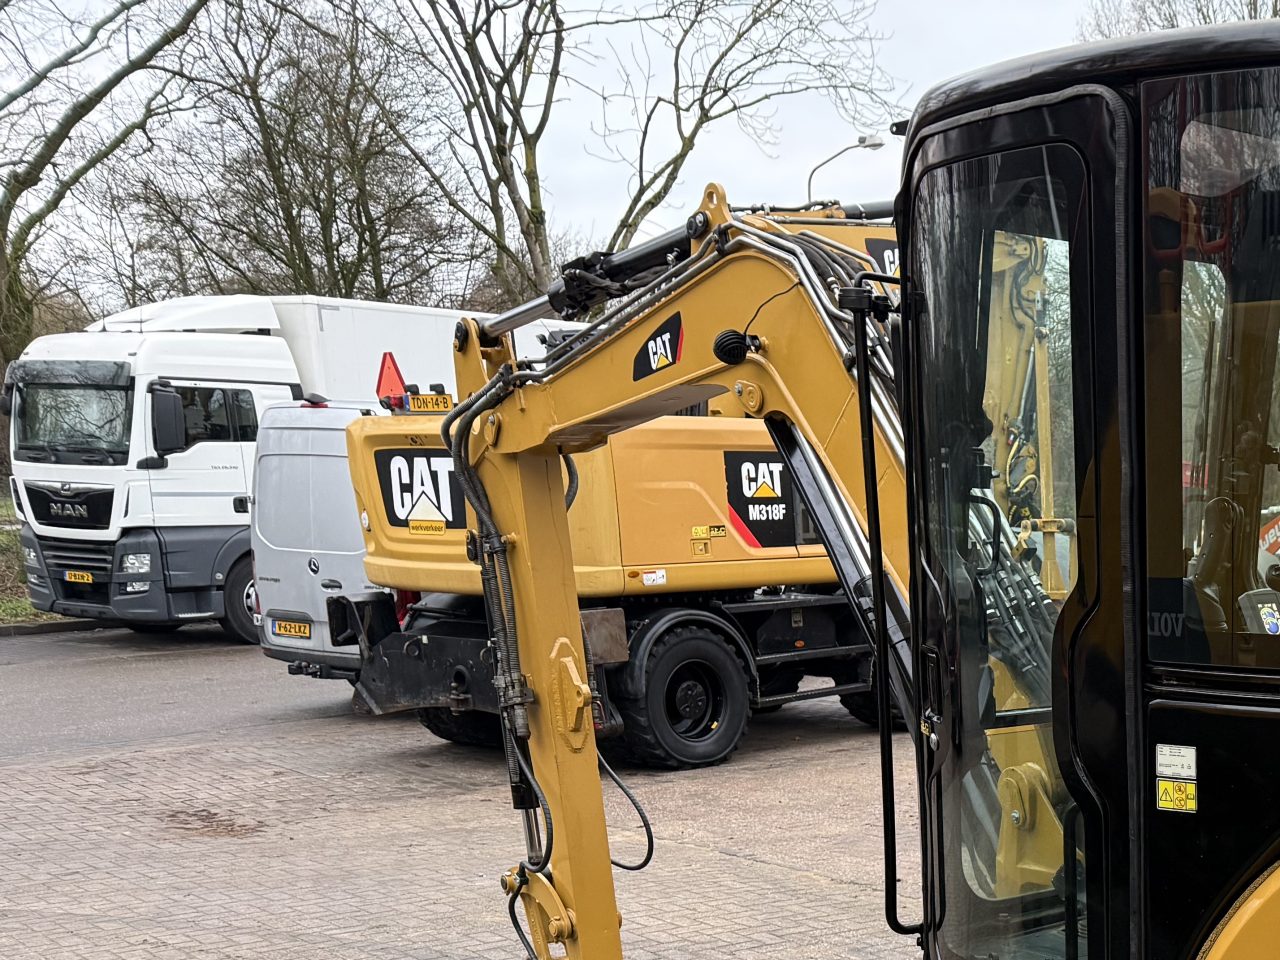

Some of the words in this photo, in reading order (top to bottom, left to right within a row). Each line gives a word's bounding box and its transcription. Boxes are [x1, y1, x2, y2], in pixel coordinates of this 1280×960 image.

[647, 332, 673, 370] CAT
[411, 396, 449, 409] TDN-14-B
[741, 461, 784, 498] CAT
[390, 455, 455, 522] CAT
[49, 502, 88, 518] MAN
[748, 503, 786, 520] M318F
[411, 524, 444, 533] werkverkeer
